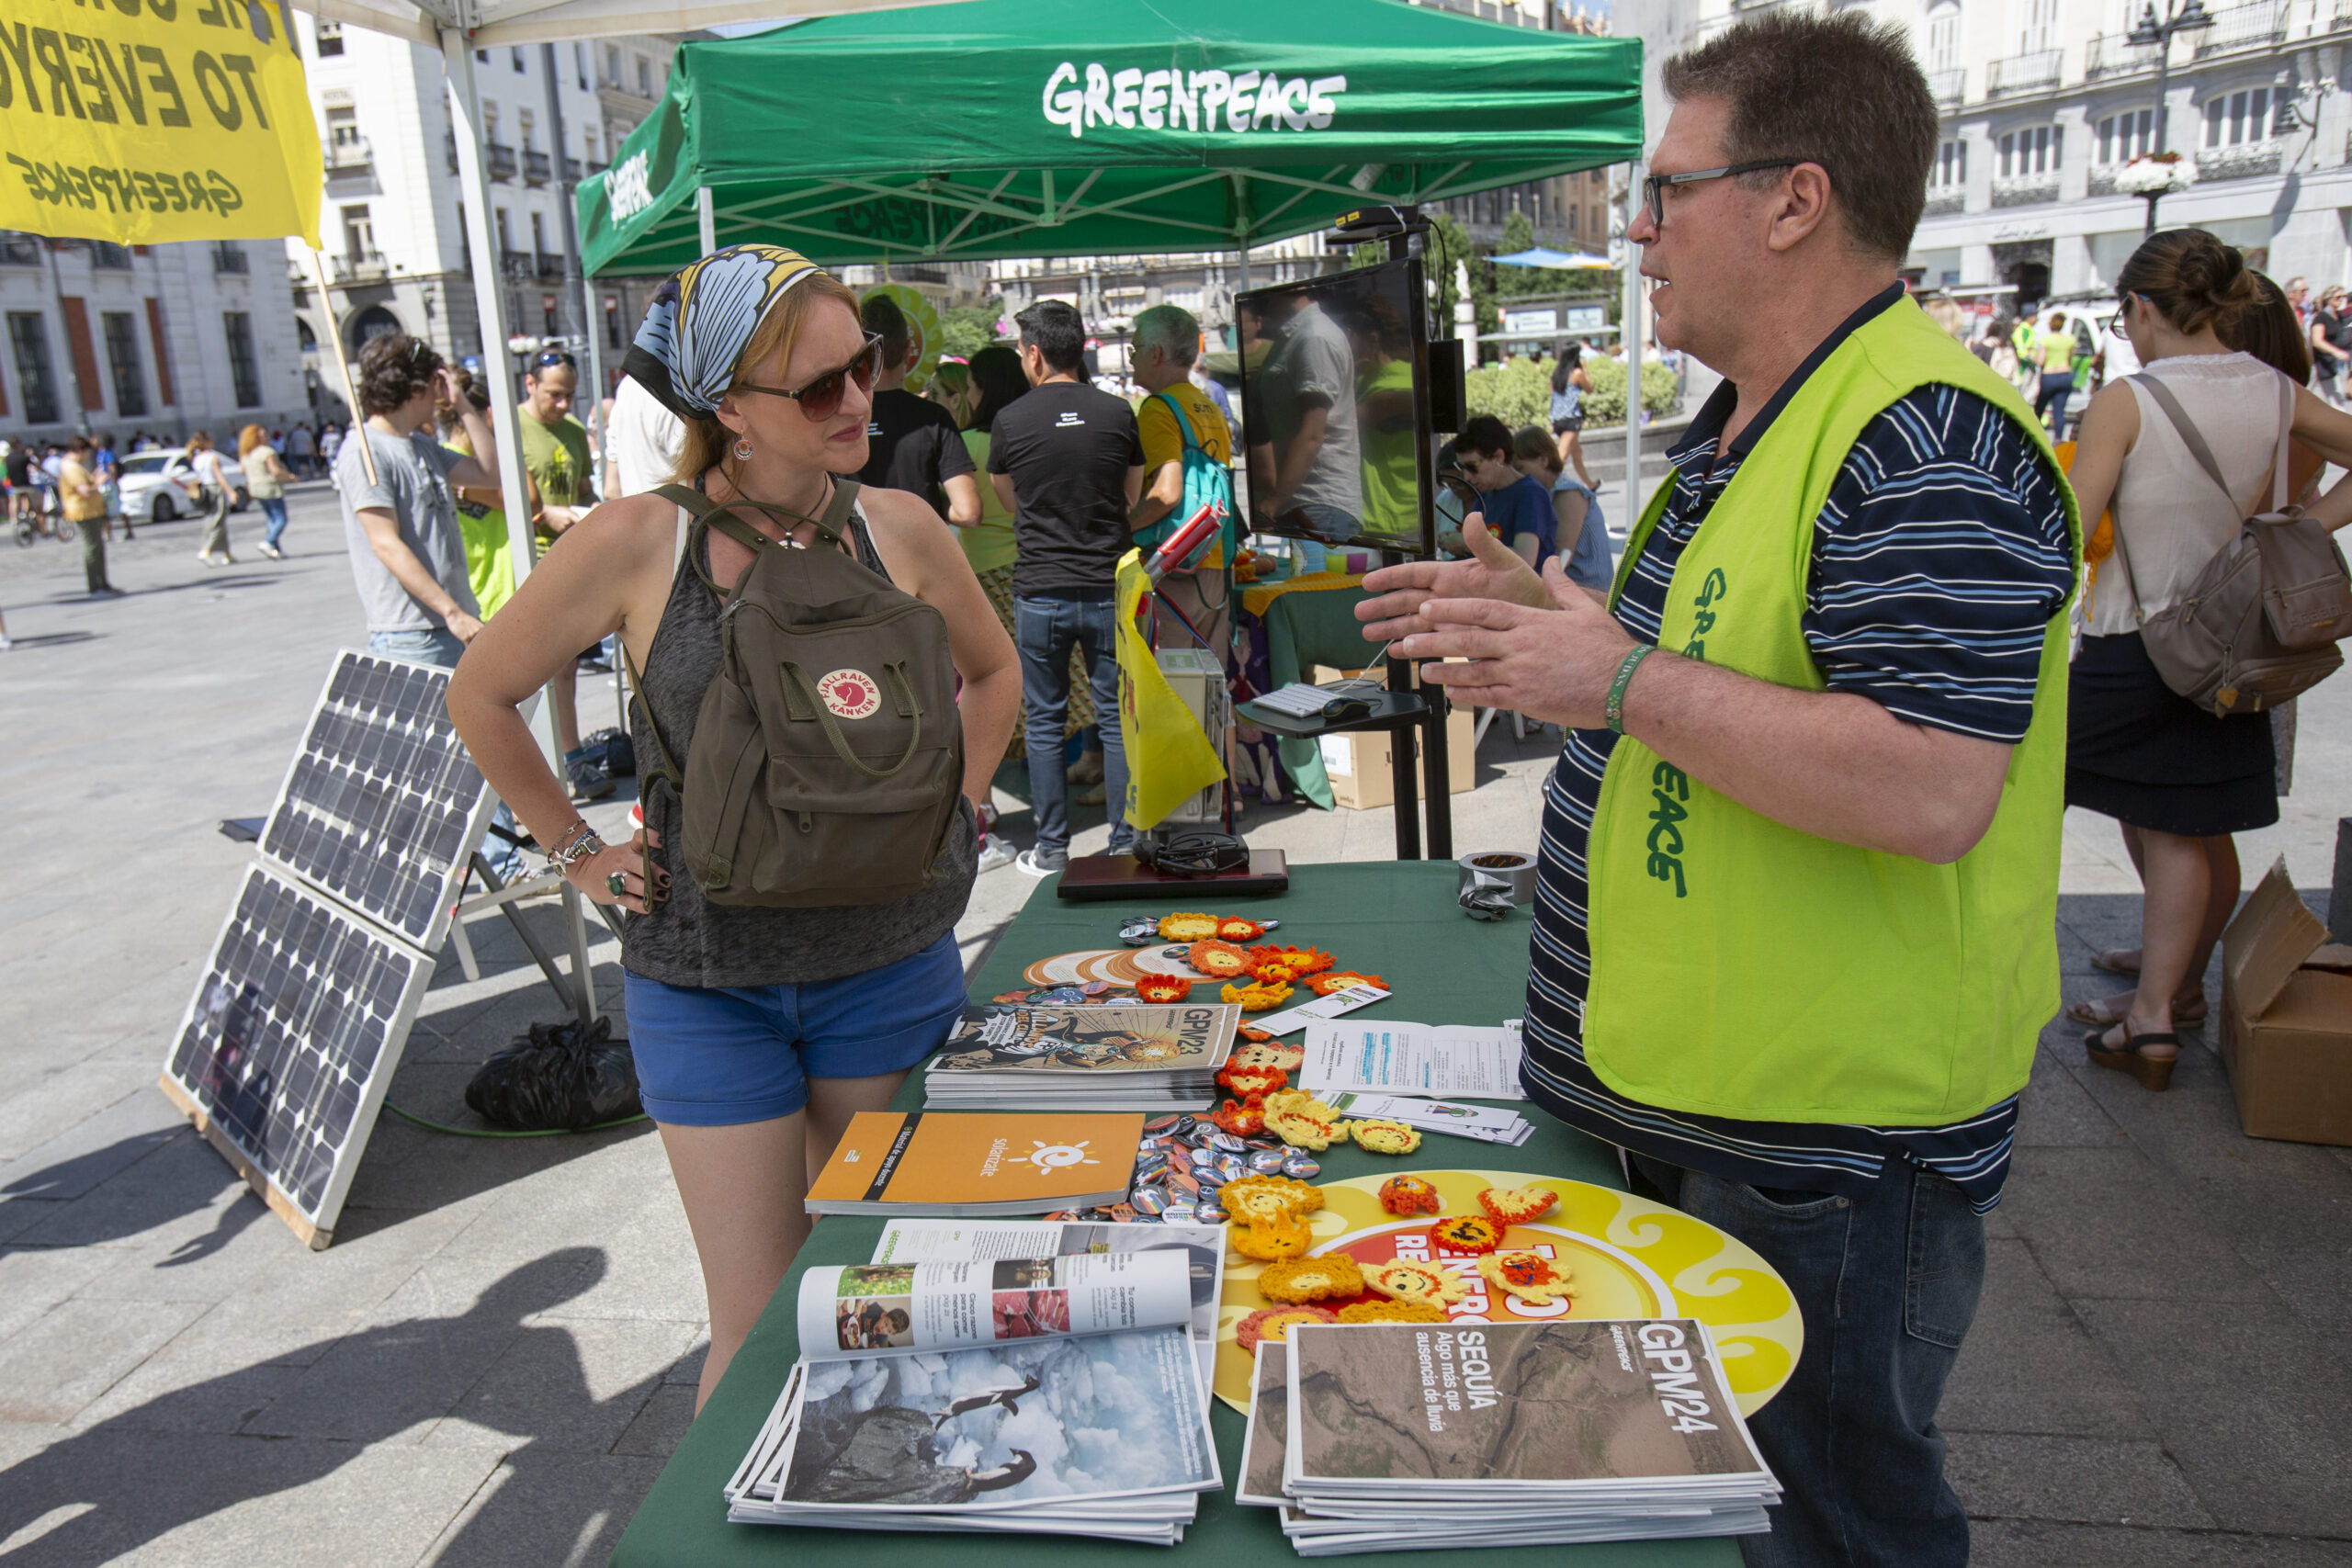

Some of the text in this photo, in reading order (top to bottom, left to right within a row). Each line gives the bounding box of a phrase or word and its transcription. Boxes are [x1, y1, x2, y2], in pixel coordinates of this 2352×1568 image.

[1042, 62, 1347, 138] GREENPEACE
[1646, 568, 1726, 898] GREEACE
[1019, 1011, 1047, 1048] VILLANOS
[1180, 1009, 1213, 1055] GPM23
[895, 1131, 911, 1149] Material
[875, 1169, 890, 1187] docente
[1119, 1287, 1127, 1313] cambia
[1436, 1331, 1462, 1412] Algo más que
[1456, 1331, 1504, 1410] SEQUÍA
[1610, 1325, 1634, 1372] GREENPEACE
[1637, 1324, 1719, 1434] GPM24
[1416, 1332, 1447, 1433] ausencia de lluvia
